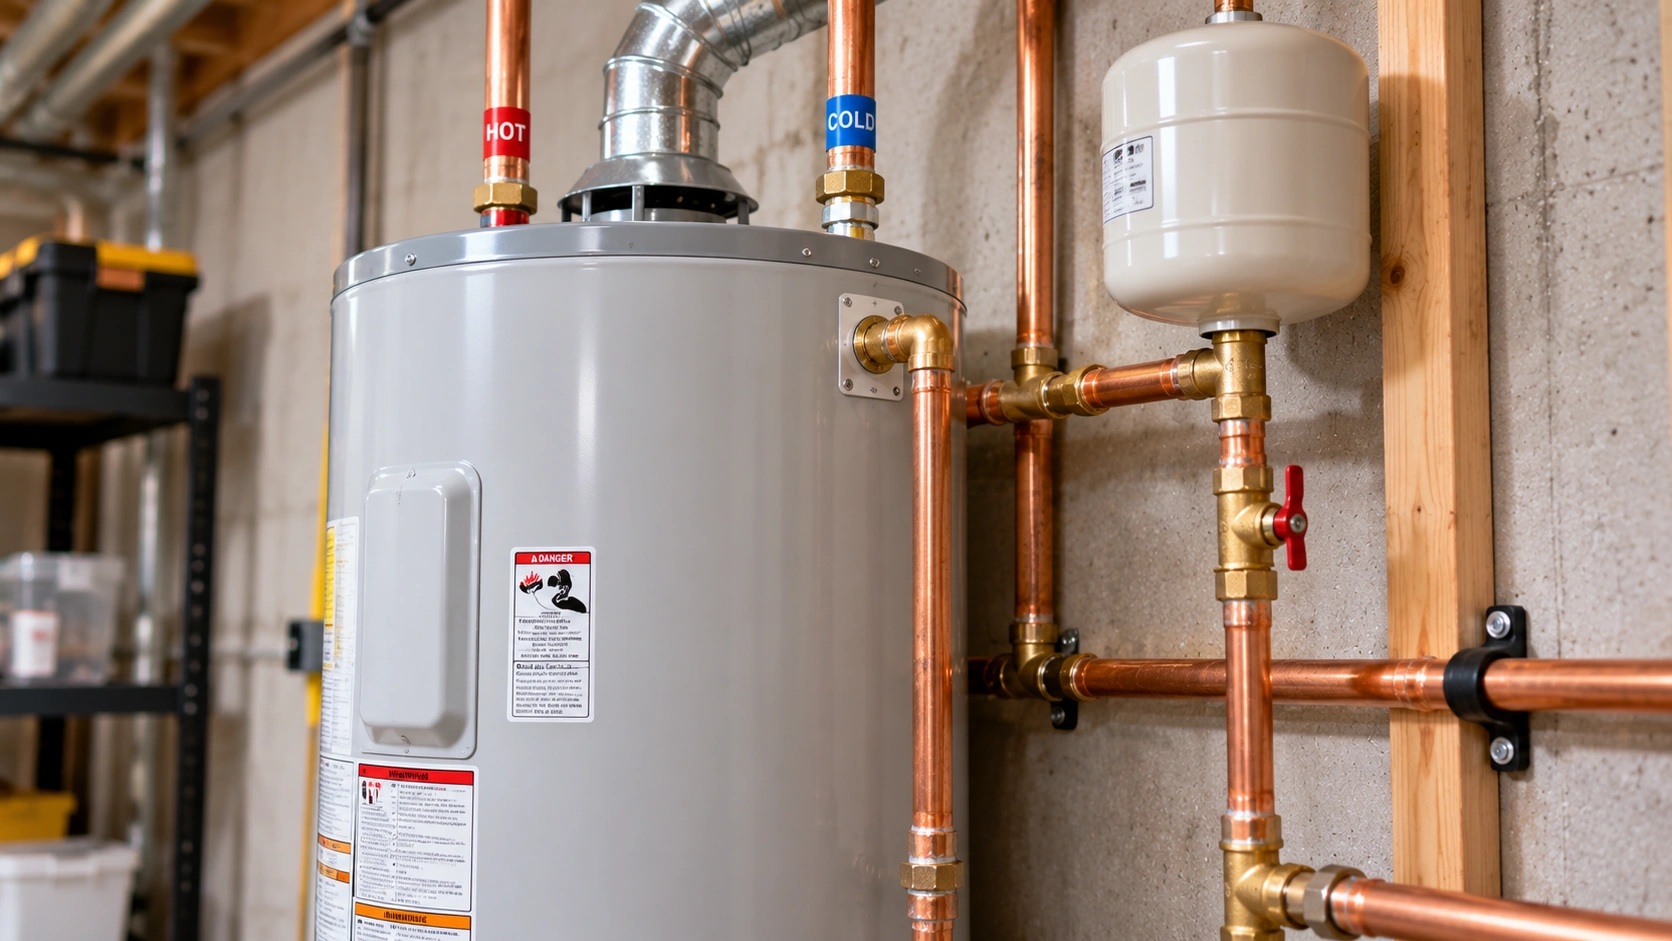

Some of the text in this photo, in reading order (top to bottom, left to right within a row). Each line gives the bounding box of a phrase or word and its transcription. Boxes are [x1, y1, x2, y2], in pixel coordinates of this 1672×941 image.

[828, 110, 875, 131] COLD
[486, 121, 527, 142] HOT
[538, 554, 573, 563] DANGER
